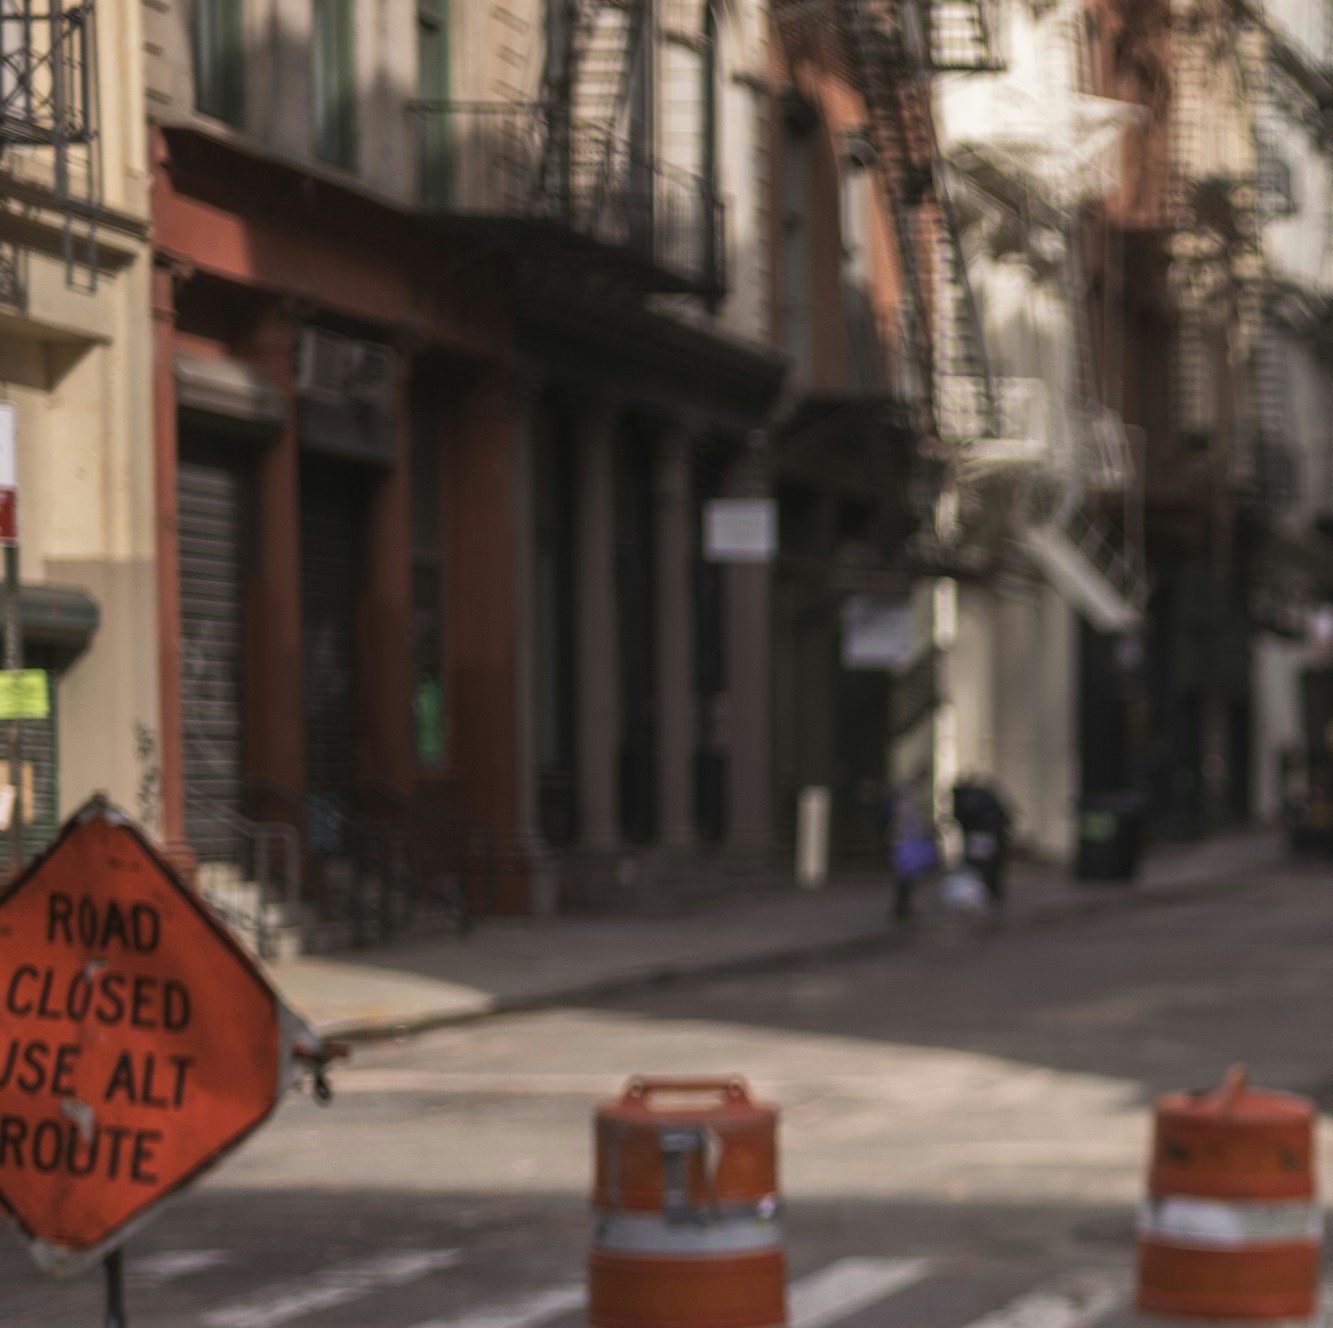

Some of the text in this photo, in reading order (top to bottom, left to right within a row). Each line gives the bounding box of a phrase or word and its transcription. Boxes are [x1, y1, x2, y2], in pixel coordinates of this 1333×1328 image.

[47, 893, 162, 952] ROAD
[6, 963, 191, 1032] CLOSED
[104, 1048, 195, 1110] ALT
[0, 1115, 163, 1185] ROUTE
